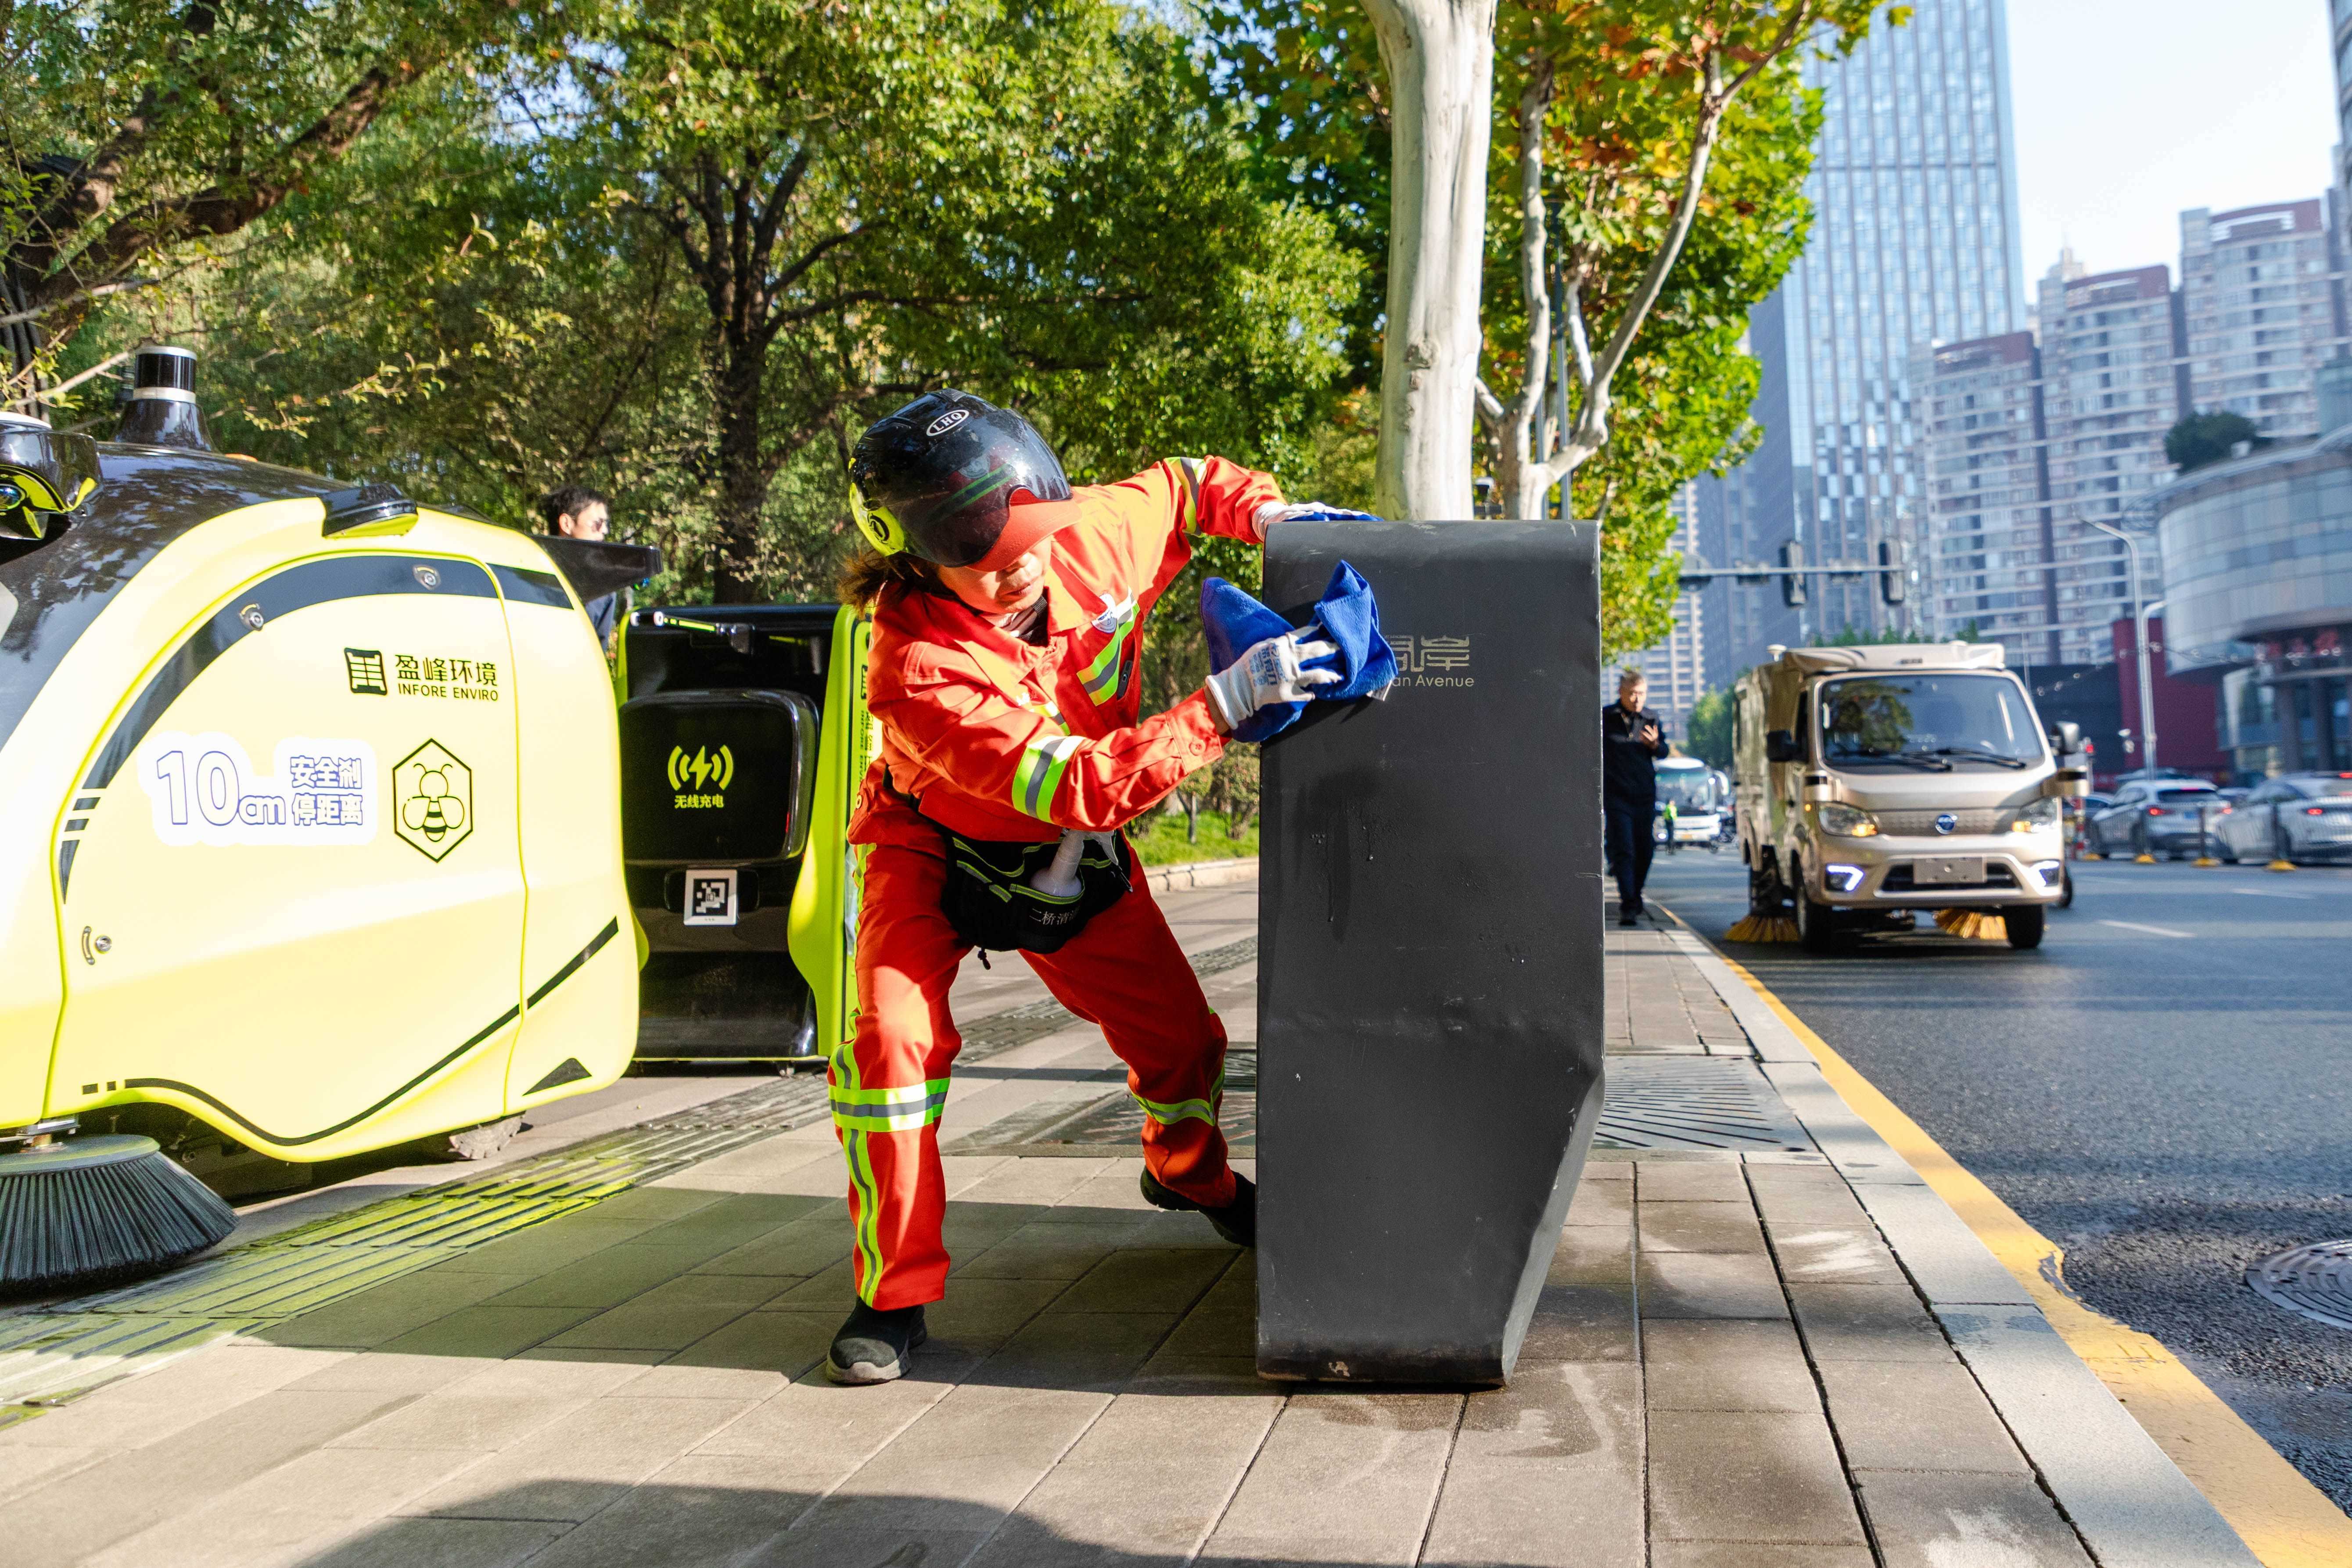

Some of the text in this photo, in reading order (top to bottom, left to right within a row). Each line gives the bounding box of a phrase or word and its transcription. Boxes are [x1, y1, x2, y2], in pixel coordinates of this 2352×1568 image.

[933, 413, 963, 431] LHQ
[395, 655, 498, 686] 盈峰环境
[1392, 675, 1474, 687] an Avenue
[398, 684, 498, 701] INFORE ENVIRO
[290, 755, 362, 789] 安全刹
[157, 751, 286, 826] 10cm
[675, 793, 724, 808] 无线充电
[292, 792, 363, 826] 停距离
